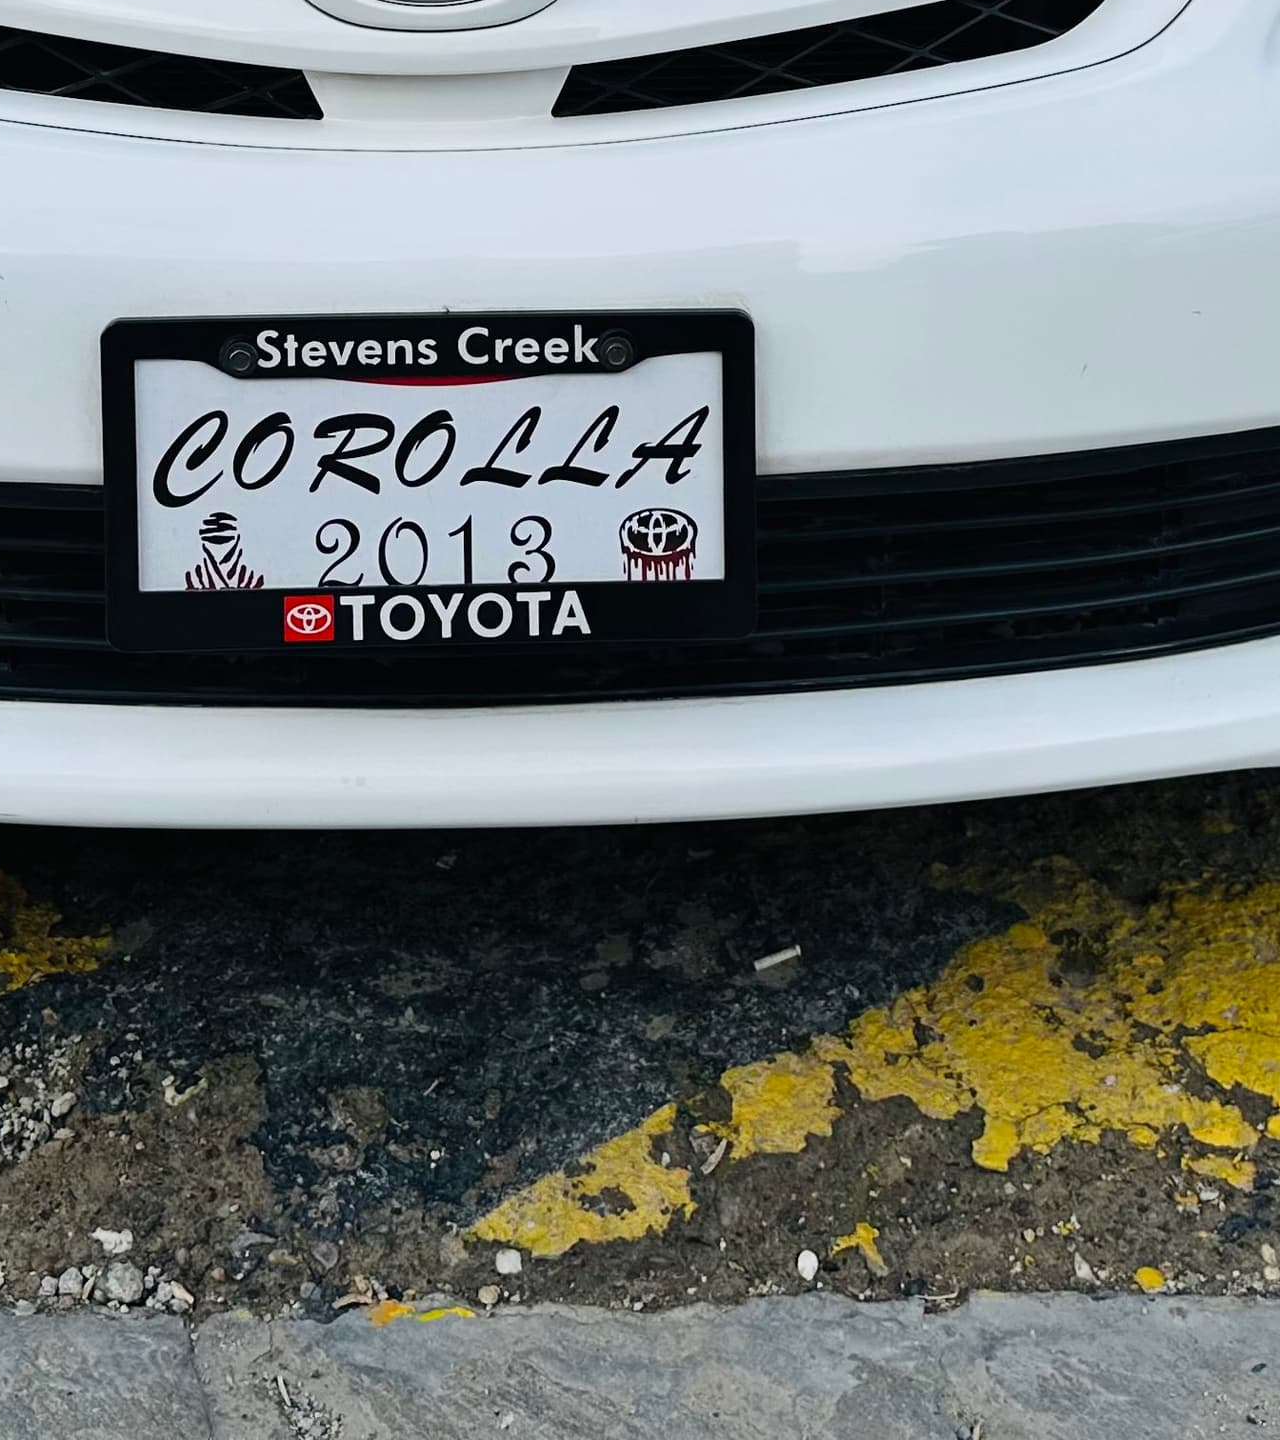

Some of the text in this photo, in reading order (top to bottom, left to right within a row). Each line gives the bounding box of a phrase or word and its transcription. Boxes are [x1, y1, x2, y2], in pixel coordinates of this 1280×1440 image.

[256, 324, 600, 368] Stevens Creek
[152, 405, 710, 508] COROLLA
[315, 514, 557, 587] 2013
[339, 590, 592, 641] TOYOTA
